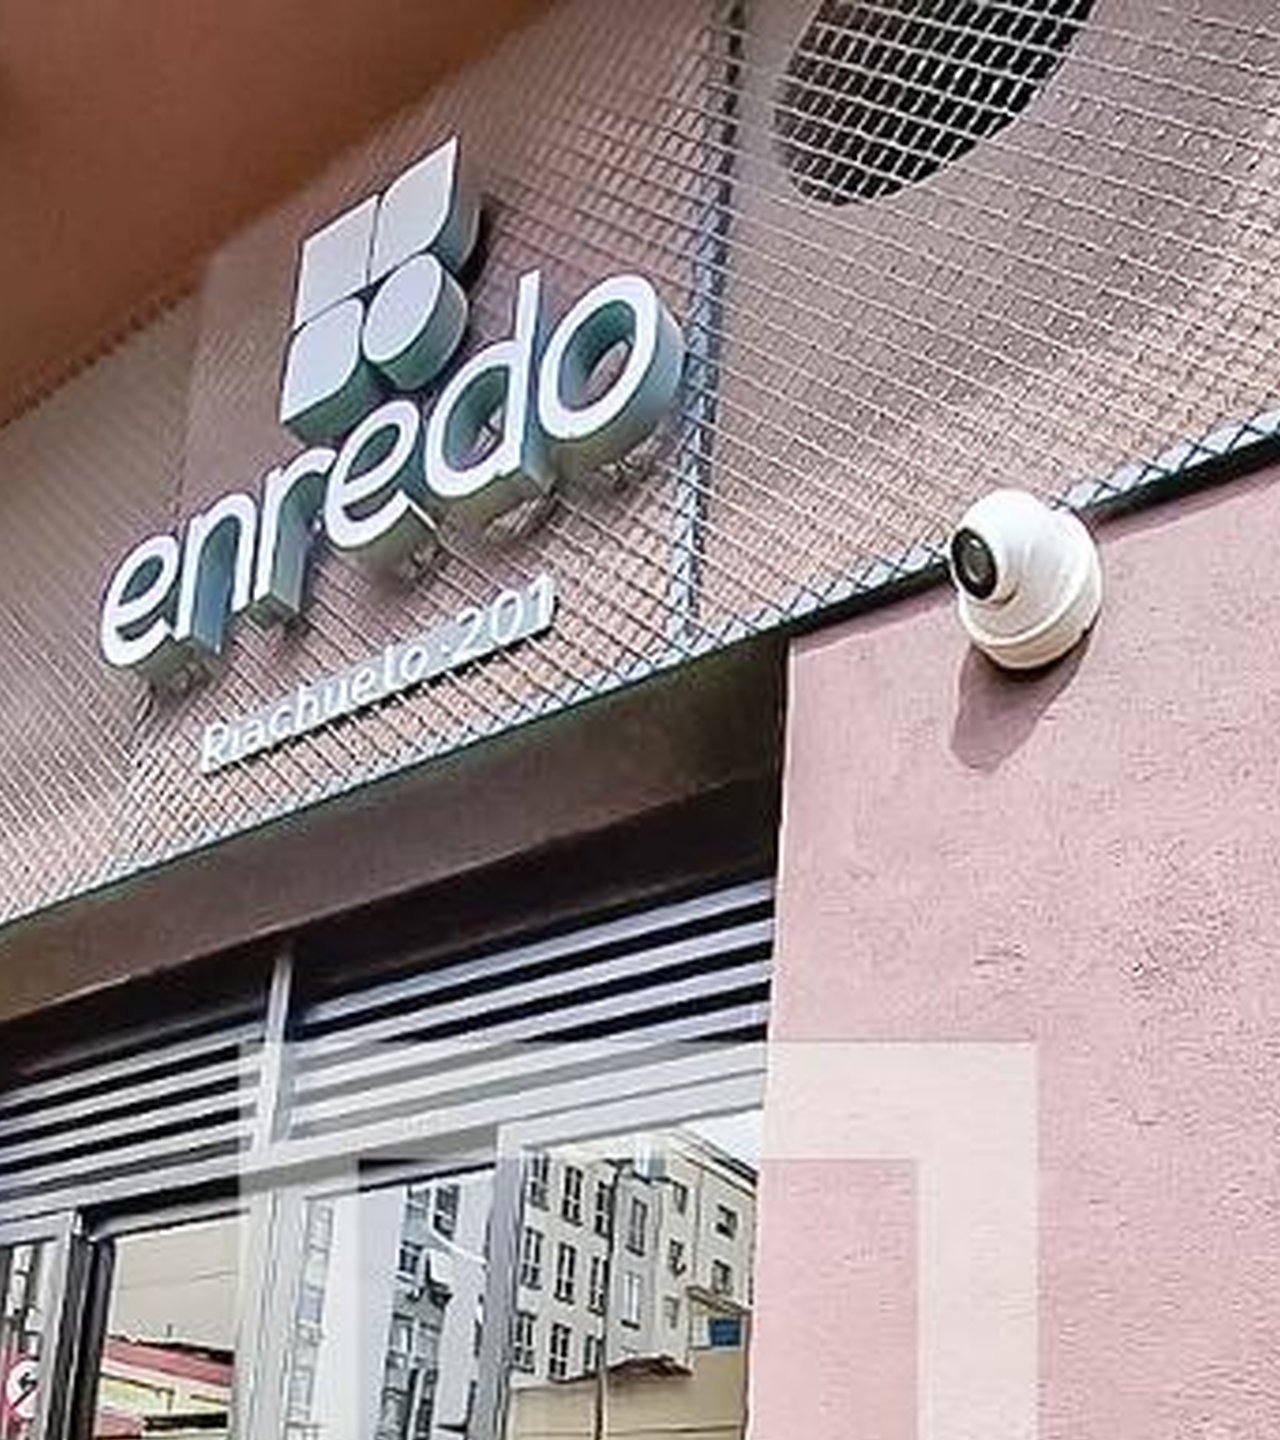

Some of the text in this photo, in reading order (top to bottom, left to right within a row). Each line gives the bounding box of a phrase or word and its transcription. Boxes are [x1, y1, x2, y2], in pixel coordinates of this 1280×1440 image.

[100, 269, 662, 668] enredo
[201, 572, 556, 772] Riachuelo 201
